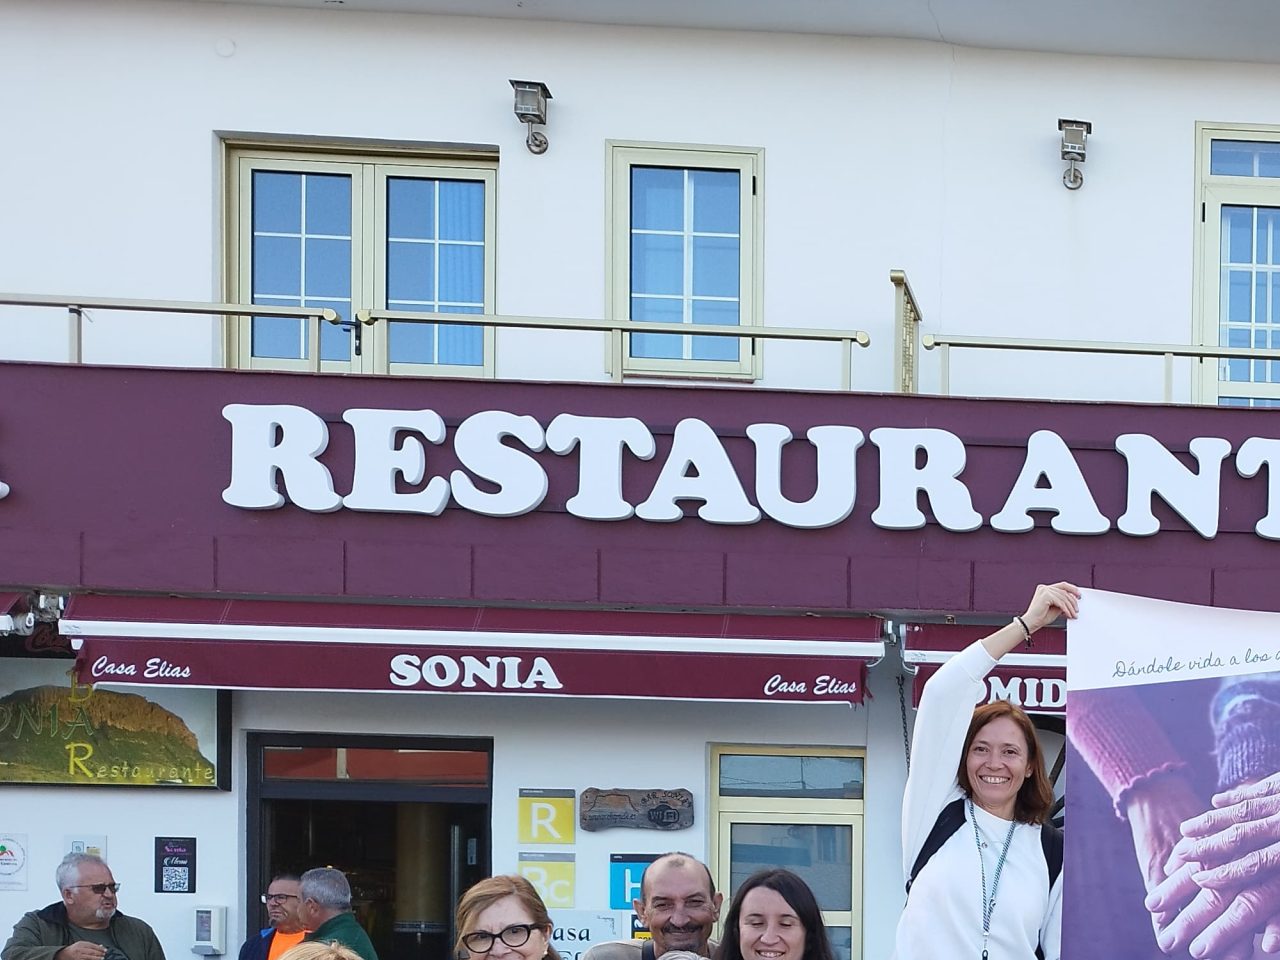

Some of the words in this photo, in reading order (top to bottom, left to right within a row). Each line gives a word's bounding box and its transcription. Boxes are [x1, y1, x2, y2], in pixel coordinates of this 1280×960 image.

[92, 655, 137, 678] Casa
[144, 657, 192, 679] Elias
[389, 653, 564, 695] SONIA
[1112, 656, 1186, 678] Dándole
[1188, 651, 1224, 669] vida
[1230, 655, 1240, 666] a
[1245, 648, 1272, 663] los
[763, 672, 808, 696] Casa
[813, 674, 858, 698] Elias
[976, 675, 1067, 707] MID
[531, 802, 561, 839] R
[552, 927, 591, 942] asa
